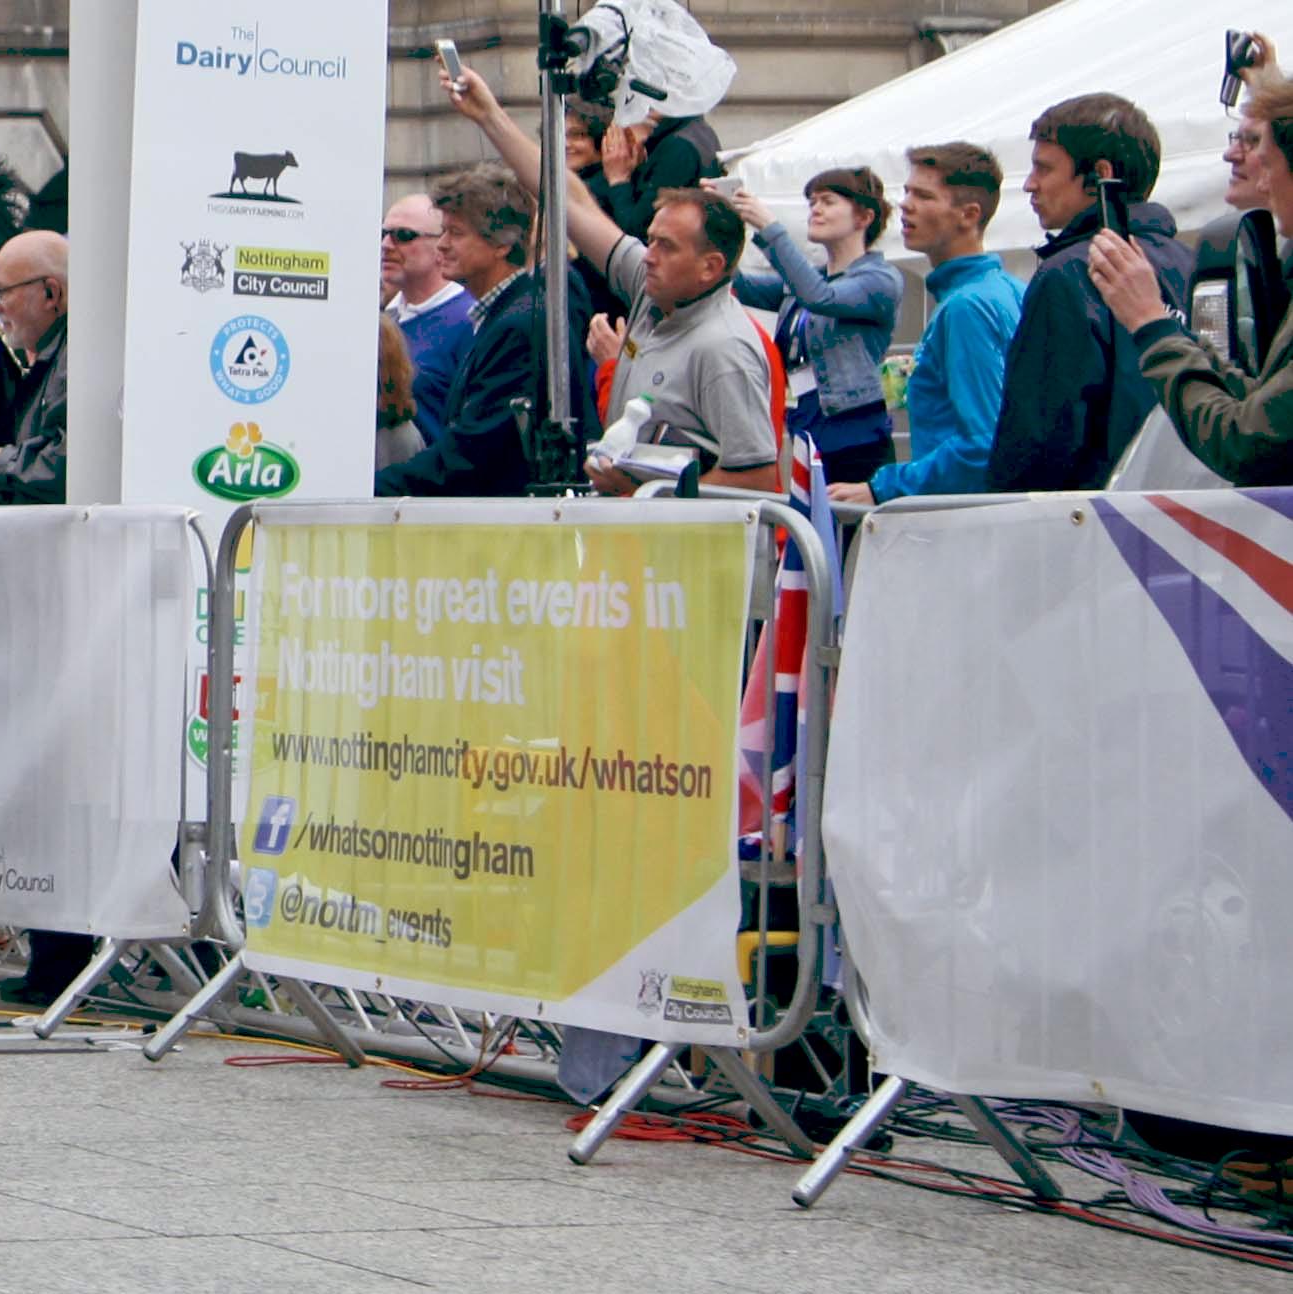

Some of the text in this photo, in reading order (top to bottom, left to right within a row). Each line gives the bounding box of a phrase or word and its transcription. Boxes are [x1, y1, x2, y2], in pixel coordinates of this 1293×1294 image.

[231, 26, 255, 41] The
[176, 41, 347, 79] Dairy Council
[238, 250, 325, 271] Nottingham
[237, 274, 325, 296] City Council
[228, 366, 270, 377] Tetra Pak
[207, 452, 282, 487] Arla
[281, 561, 687, 635] For more great events in
[279, 638, 445, 710] Nottingham
[452, 642, 526, 706] visit
[272, 731, 712, 798] www.nottinghamcity.gov.uk/whatson
[294, 811, 535, 880] /whatsonnottingham
[6, 868, 55, 893] Council
